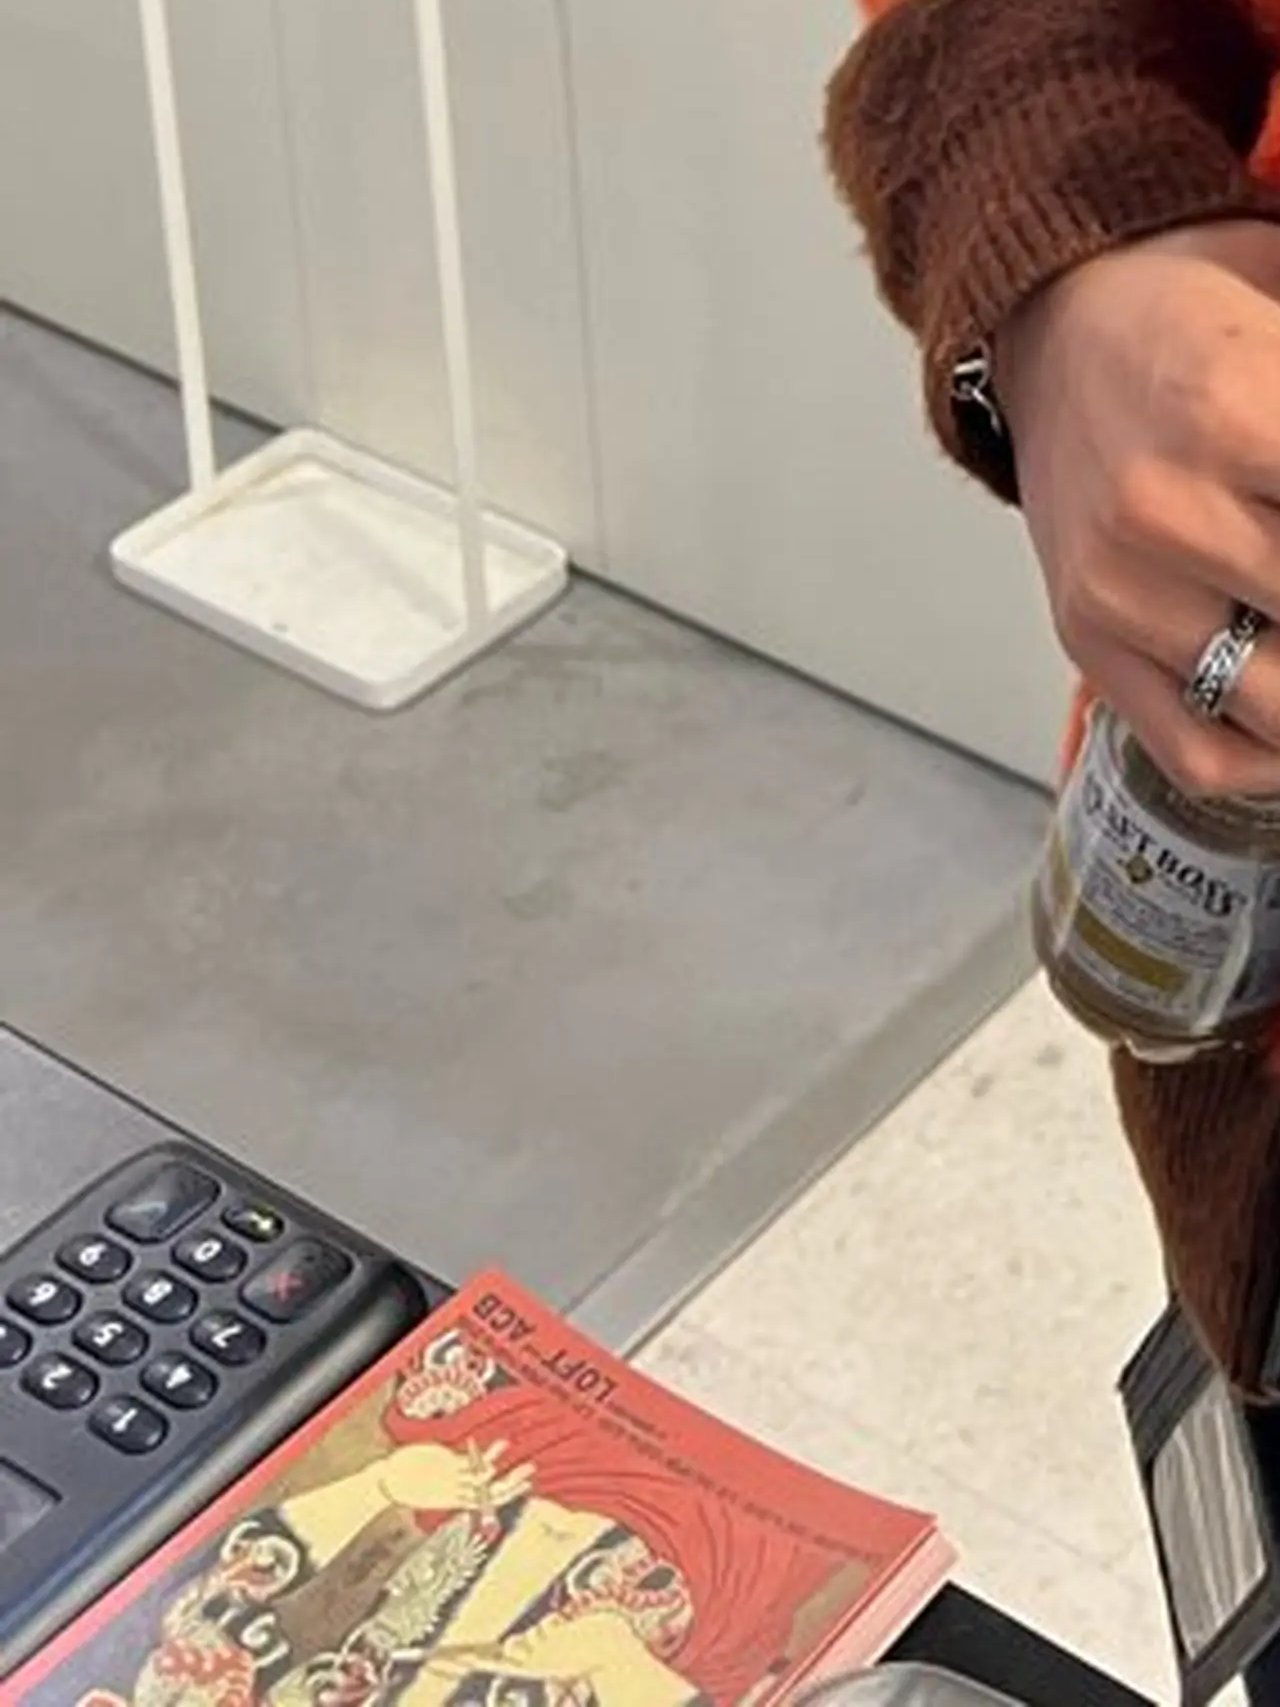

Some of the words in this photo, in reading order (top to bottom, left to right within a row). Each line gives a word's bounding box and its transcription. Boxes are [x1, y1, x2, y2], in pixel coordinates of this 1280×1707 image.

[79, 1243, 107, 1267] 9
[193, 1239, 222, 1262] 0
[29, 1281, 58, 1306] 6
[142, 1279, 173, 1305] 8
[93, 1322, 124, 1347] 5
[212, 1324, 242, 1348] 7
[43, 1363, 73, 1390] 2
[165, 1363, 193, 1389] 4
[540, 1348, 619, 1403] LOFT
[112, 1407, 138, 1432] 1
